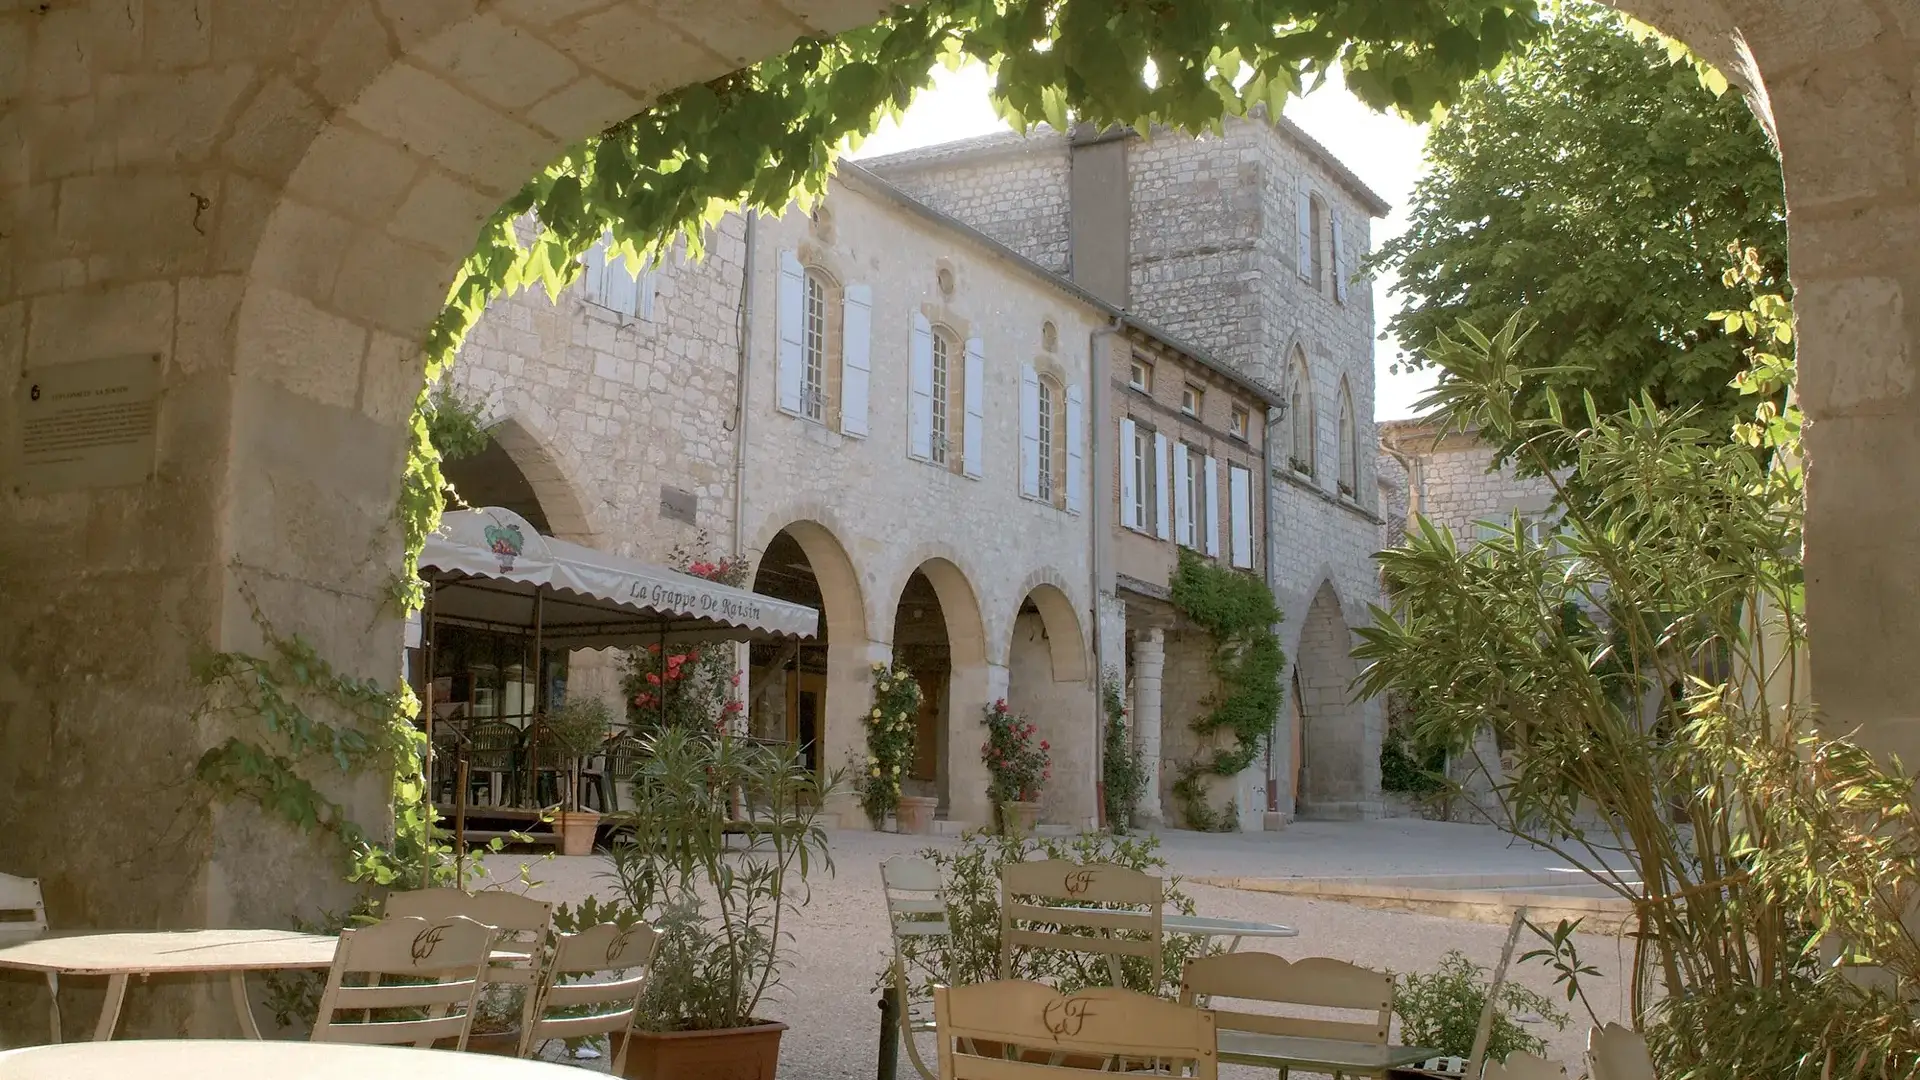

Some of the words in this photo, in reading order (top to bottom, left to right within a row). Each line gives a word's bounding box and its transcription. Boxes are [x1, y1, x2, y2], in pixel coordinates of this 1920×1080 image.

[31, 384, 40, 401] 6
[630, 581, 647, 598] La
[652, 584, 696, 611] Grappe
[701, 594, 718, 611] De
[723, 598, 760, 620] Raisin
